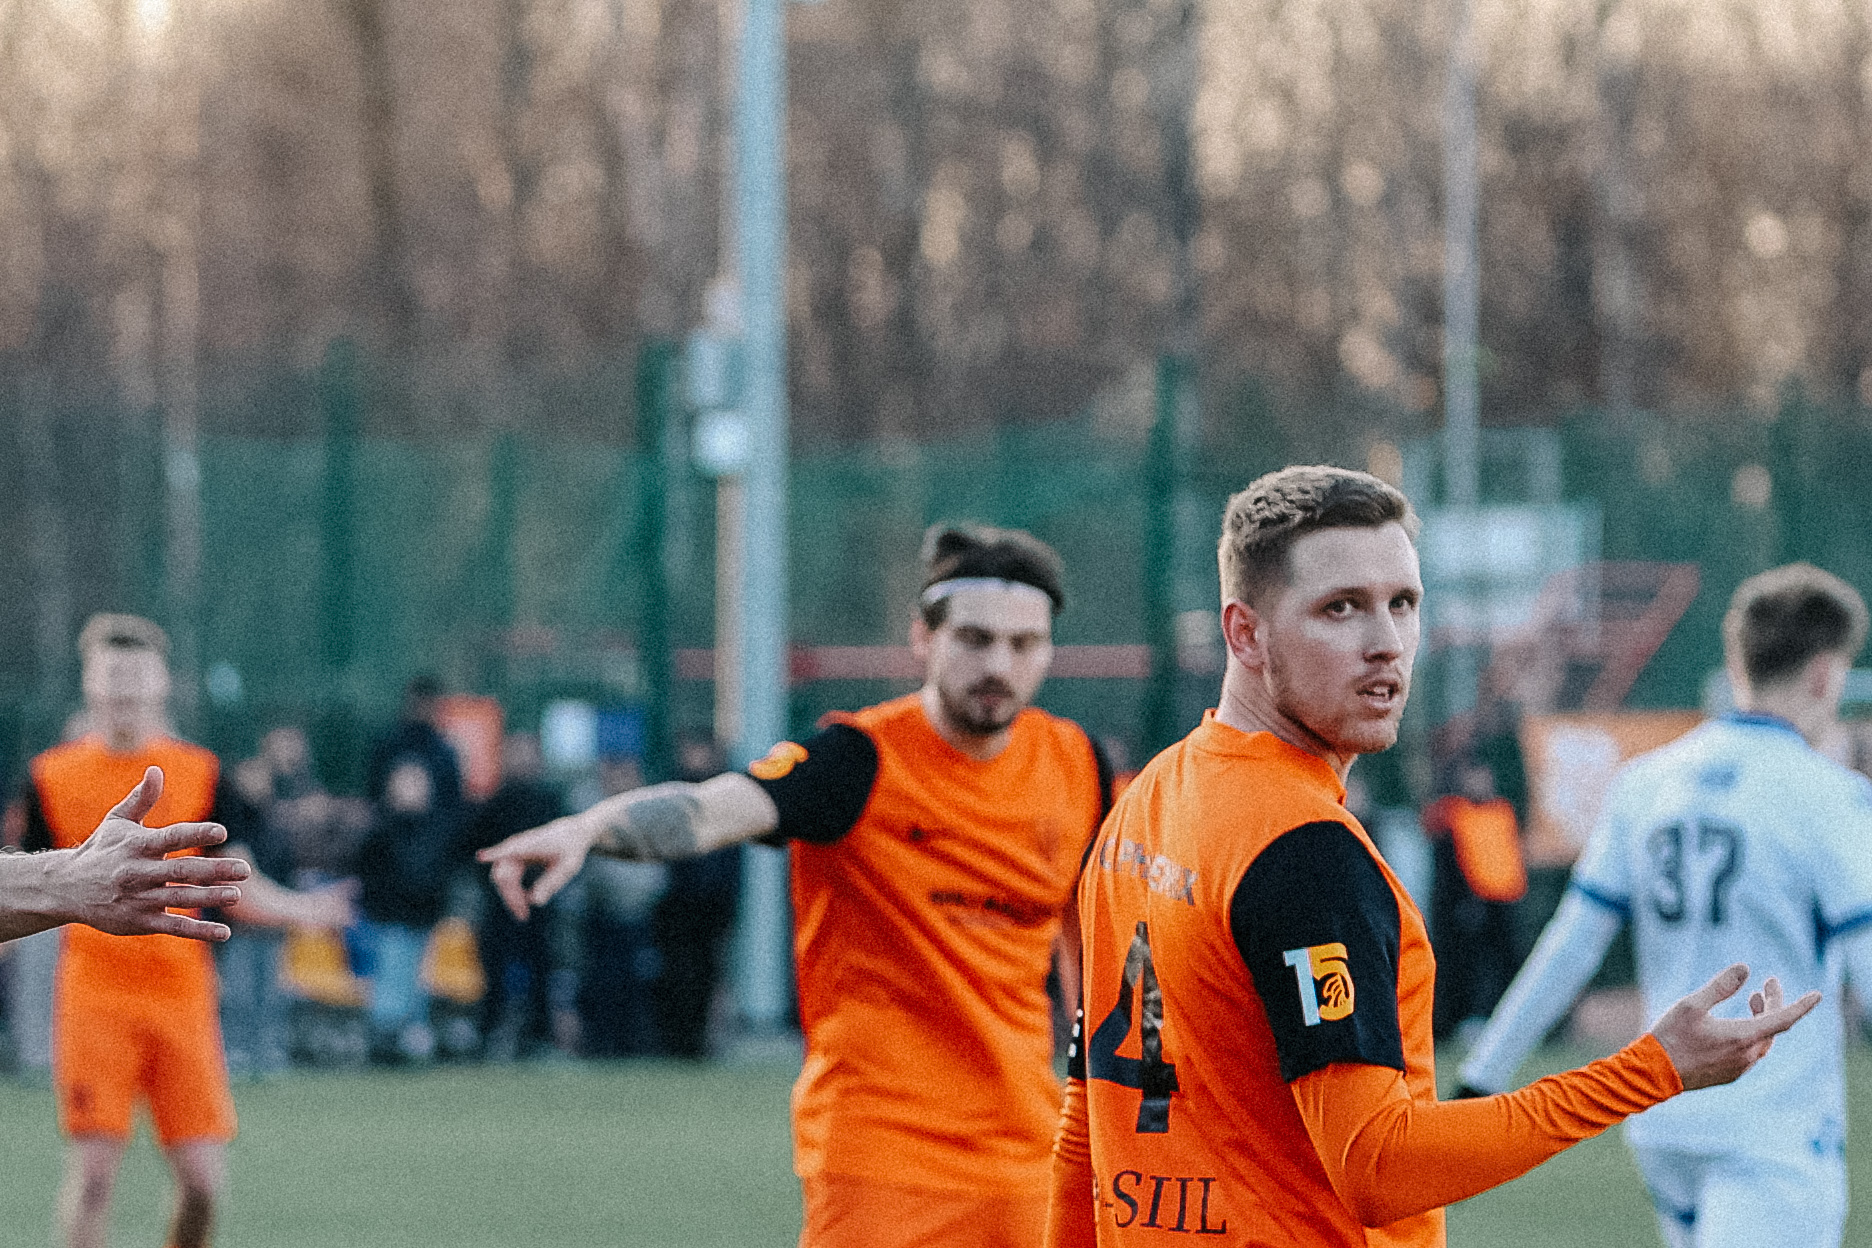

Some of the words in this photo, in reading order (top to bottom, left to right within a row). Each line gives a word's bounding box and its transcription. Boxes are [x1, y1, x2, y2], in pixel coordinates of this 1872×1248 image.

[1645, 820, 1746, 929] 37
[1087, 920, 1181, 1134] 4
[1282, 942, 1355, 1027] 15
[1091, 1168, 1227, 1235] -SIIL
